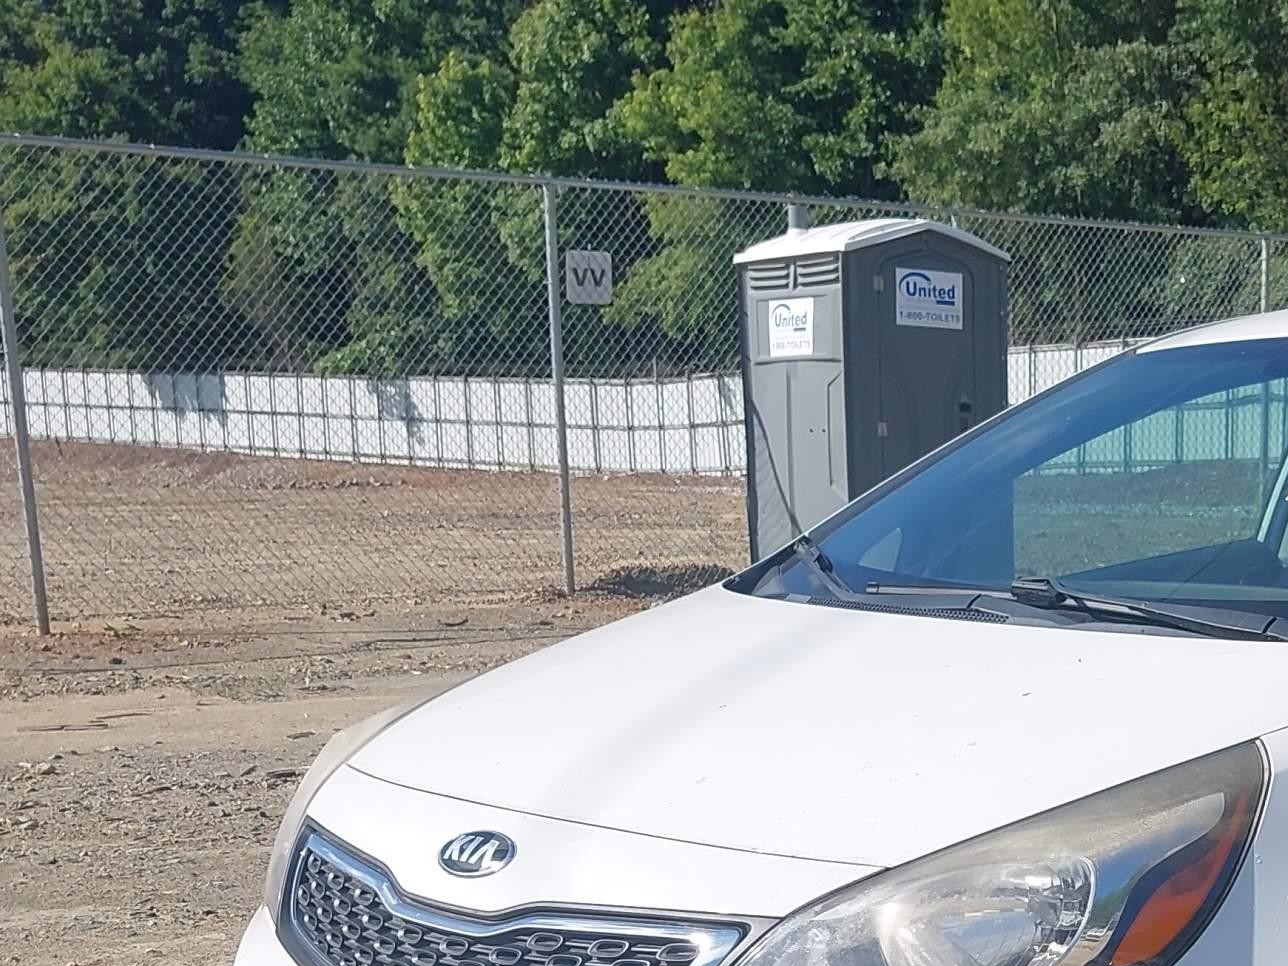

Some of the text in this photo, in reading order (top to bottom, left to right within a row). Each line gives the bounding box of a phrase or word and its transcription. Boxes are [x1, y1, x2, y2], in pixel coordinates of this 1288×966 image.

[906, 281, 955, 300] United
[774, 311, 807, 328] United
[442, 834, 502, 870] KIA
